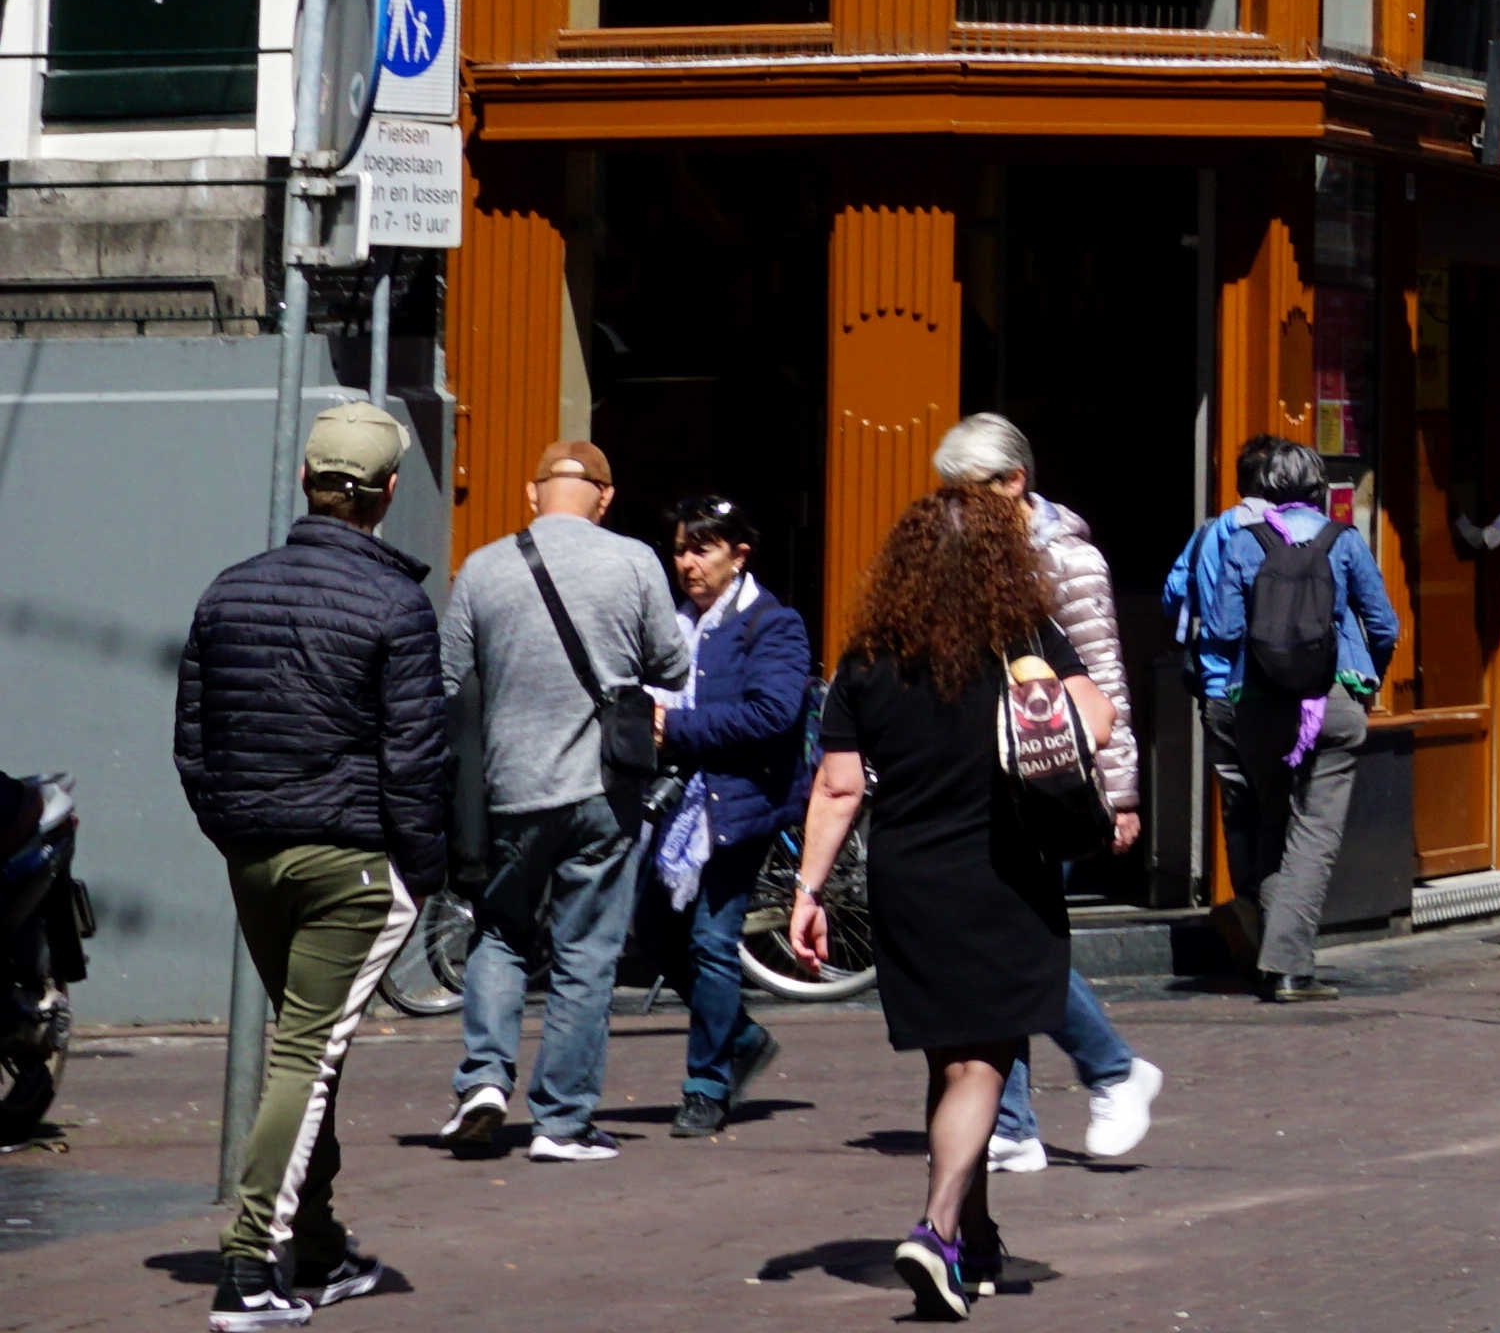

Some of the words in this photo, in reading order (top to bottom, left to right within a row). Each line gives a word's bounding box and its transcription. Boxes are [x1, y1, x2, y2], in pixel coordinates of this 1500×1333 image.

[377, 121, 430, 146] Fietsen
[363, 153, 443, 177] toegestaan
[390, 185, 409, 201] en
[412, 183, 459, 205] lossen
[405, 212, 422, 232] 19
[426, 217, 450, 234] uur
